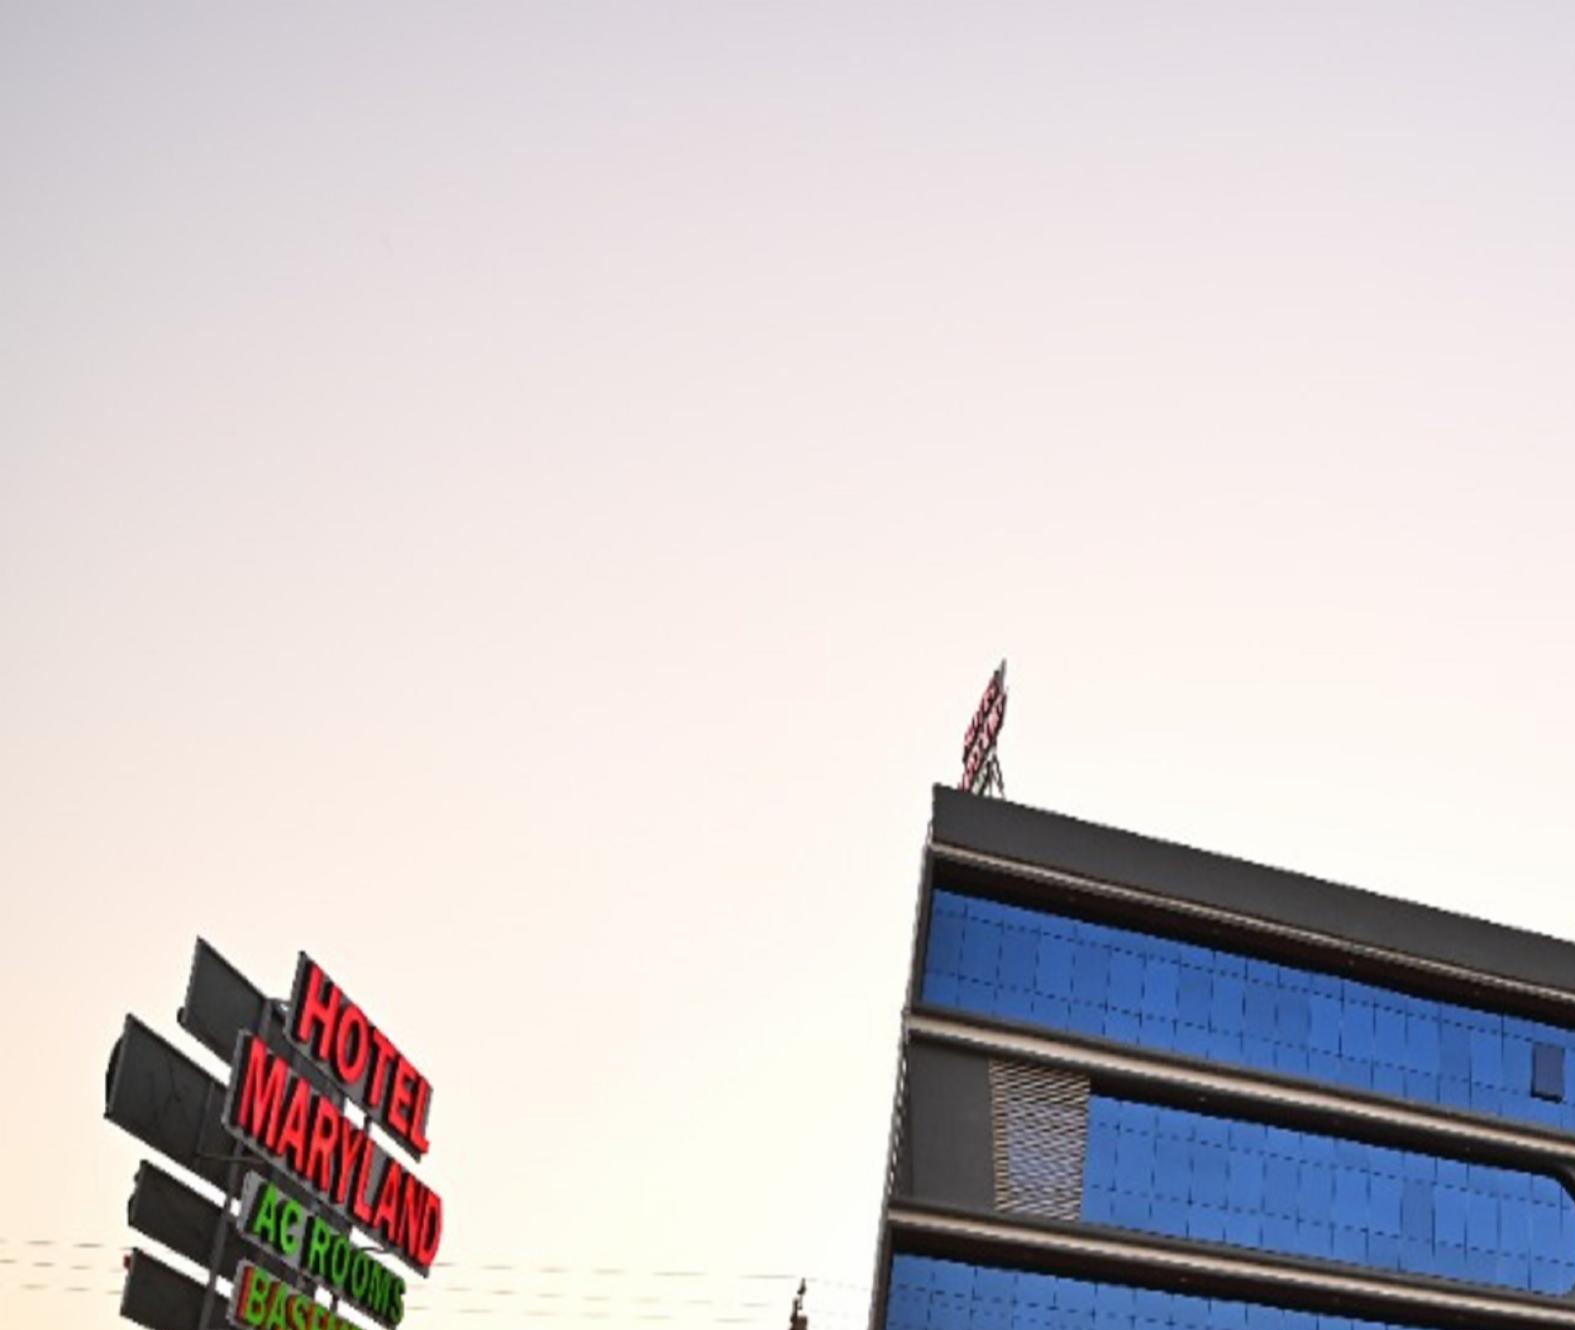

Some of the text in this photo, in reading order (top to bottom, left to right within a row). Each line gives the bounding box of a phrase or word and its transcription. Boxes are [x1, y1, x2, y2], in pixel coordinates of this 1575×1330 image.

[238, 1035, 443, 1269] MARYLAND
[298, 964, 430, 1155] HOTEL
[252, 1181, 406, 1326] AC ROOMS
